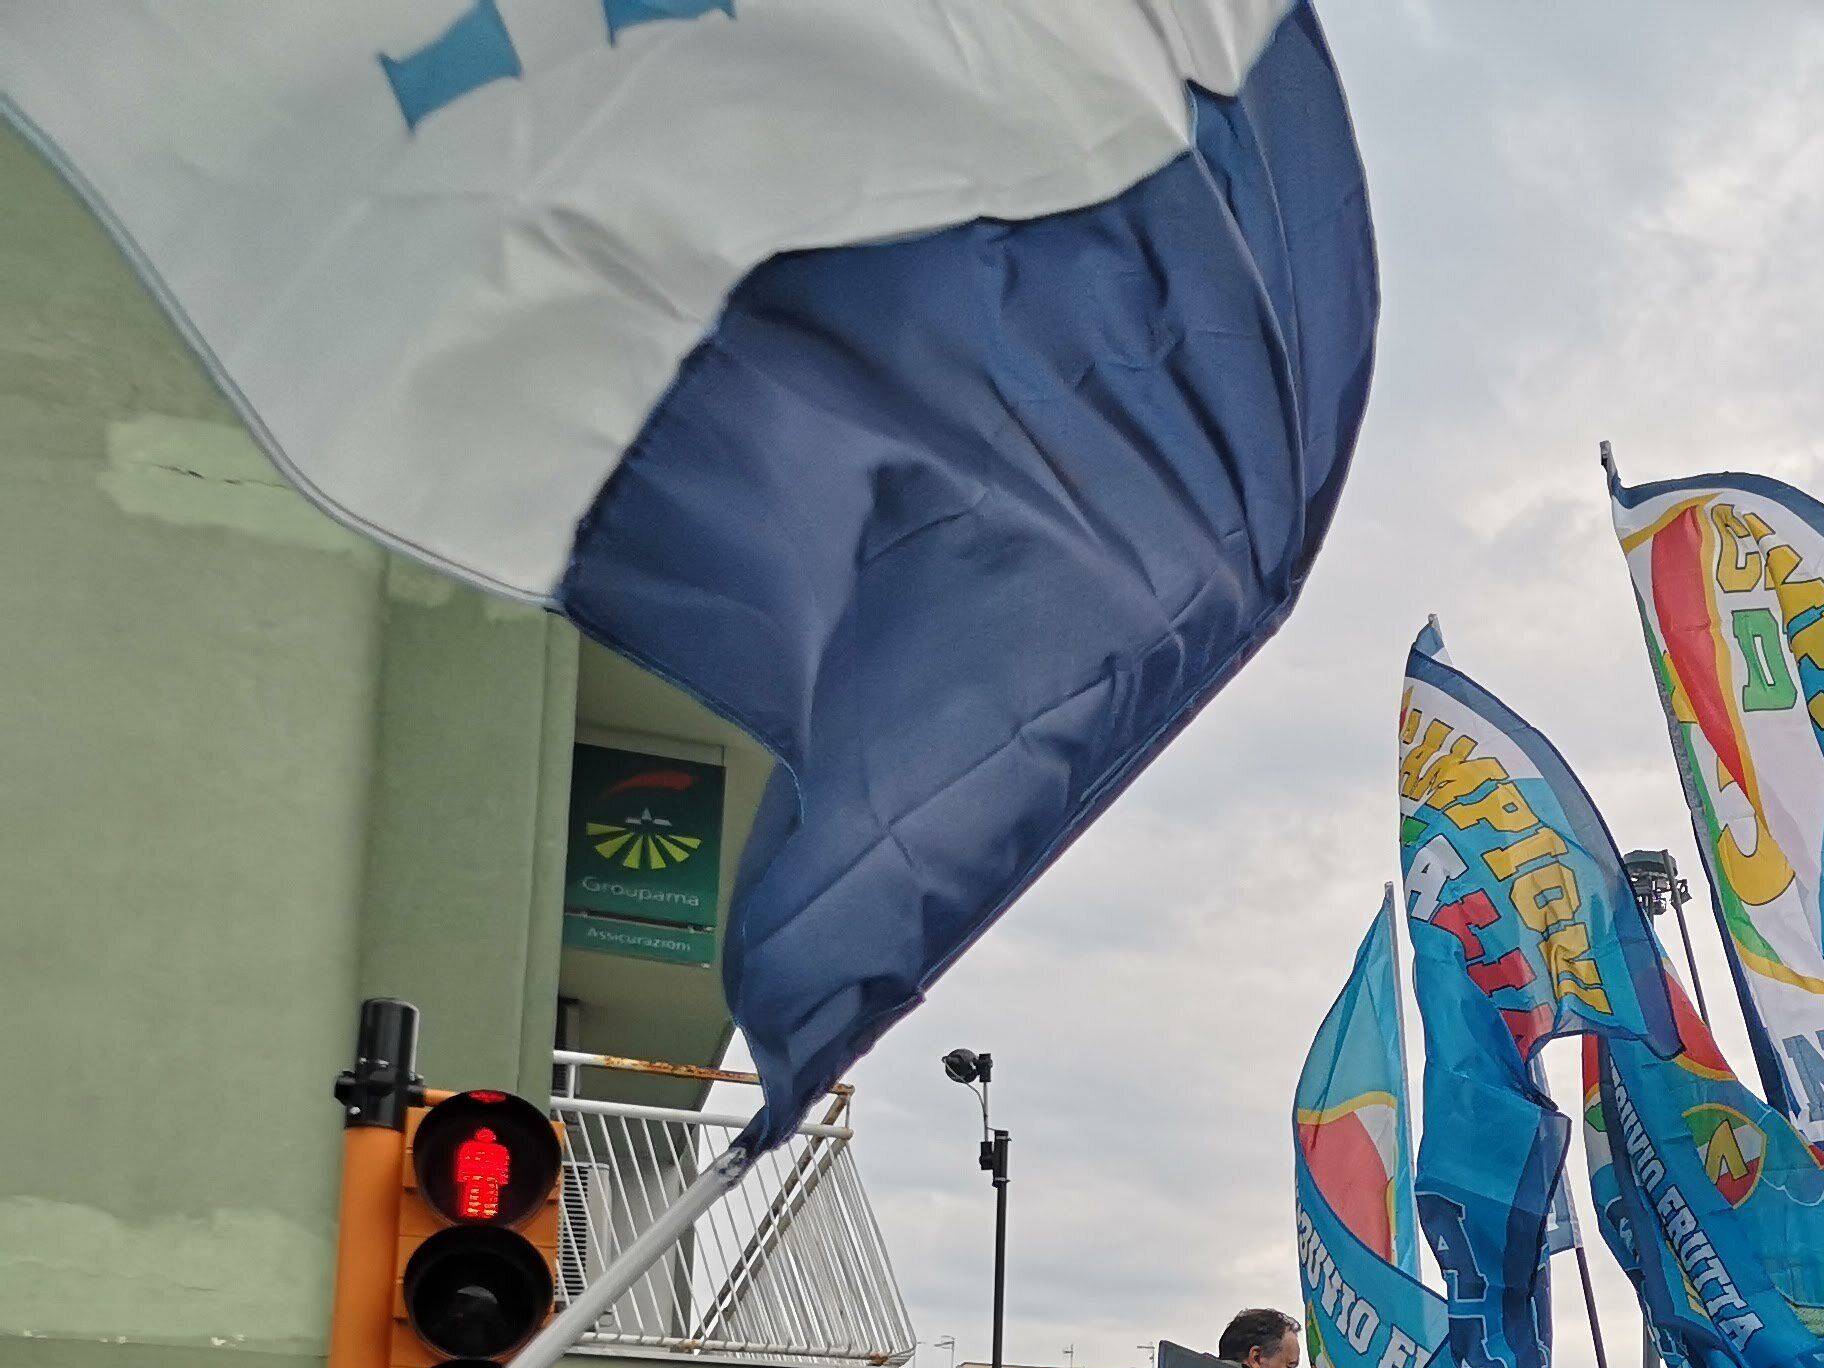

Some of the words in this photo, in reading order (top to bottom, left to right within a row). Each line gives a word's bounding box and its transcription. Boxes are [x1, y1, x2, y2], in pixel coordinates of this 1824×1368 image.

[582, 876, 700, 907] Groupama
[587, 927, 691, 951] Assicurazioni
[1657, 1185, 1765, 1352] ERUTTA
